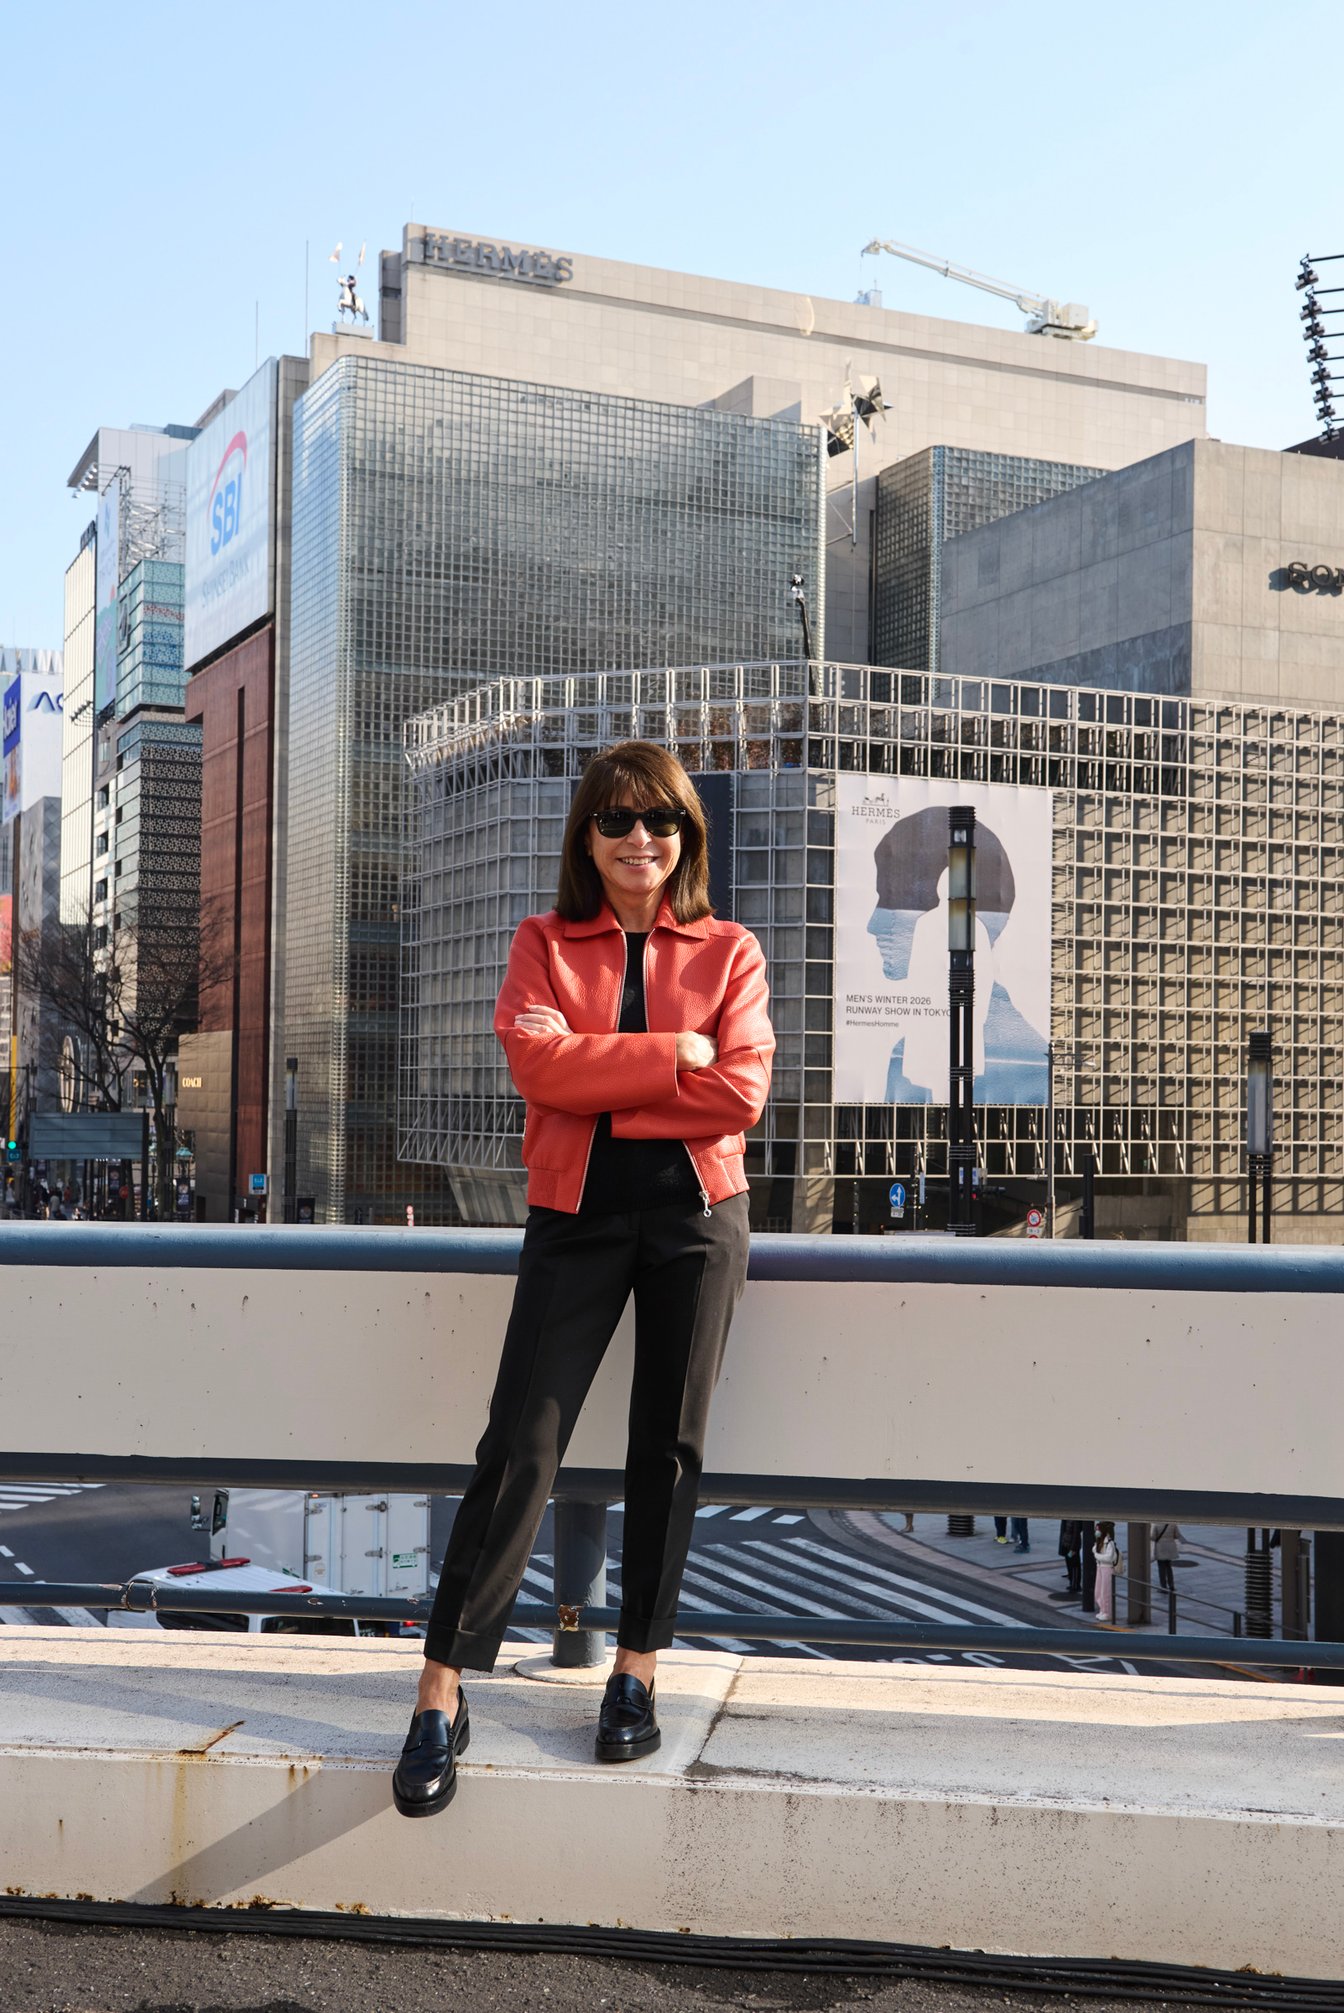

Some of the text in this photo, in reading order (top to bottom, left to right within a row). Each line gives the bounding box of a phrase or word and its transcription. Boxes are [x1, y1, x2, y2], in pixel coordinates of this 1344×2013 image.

[211, 472, 241, 556] SBI
[846, 994, 931, 1005] MEN'S WINTER 2026
[846, 1006, 882, 1014] RUNWAY
[885, 1007, 911, 1016] SHOW
[913, 1008, 921, 1016] IN
